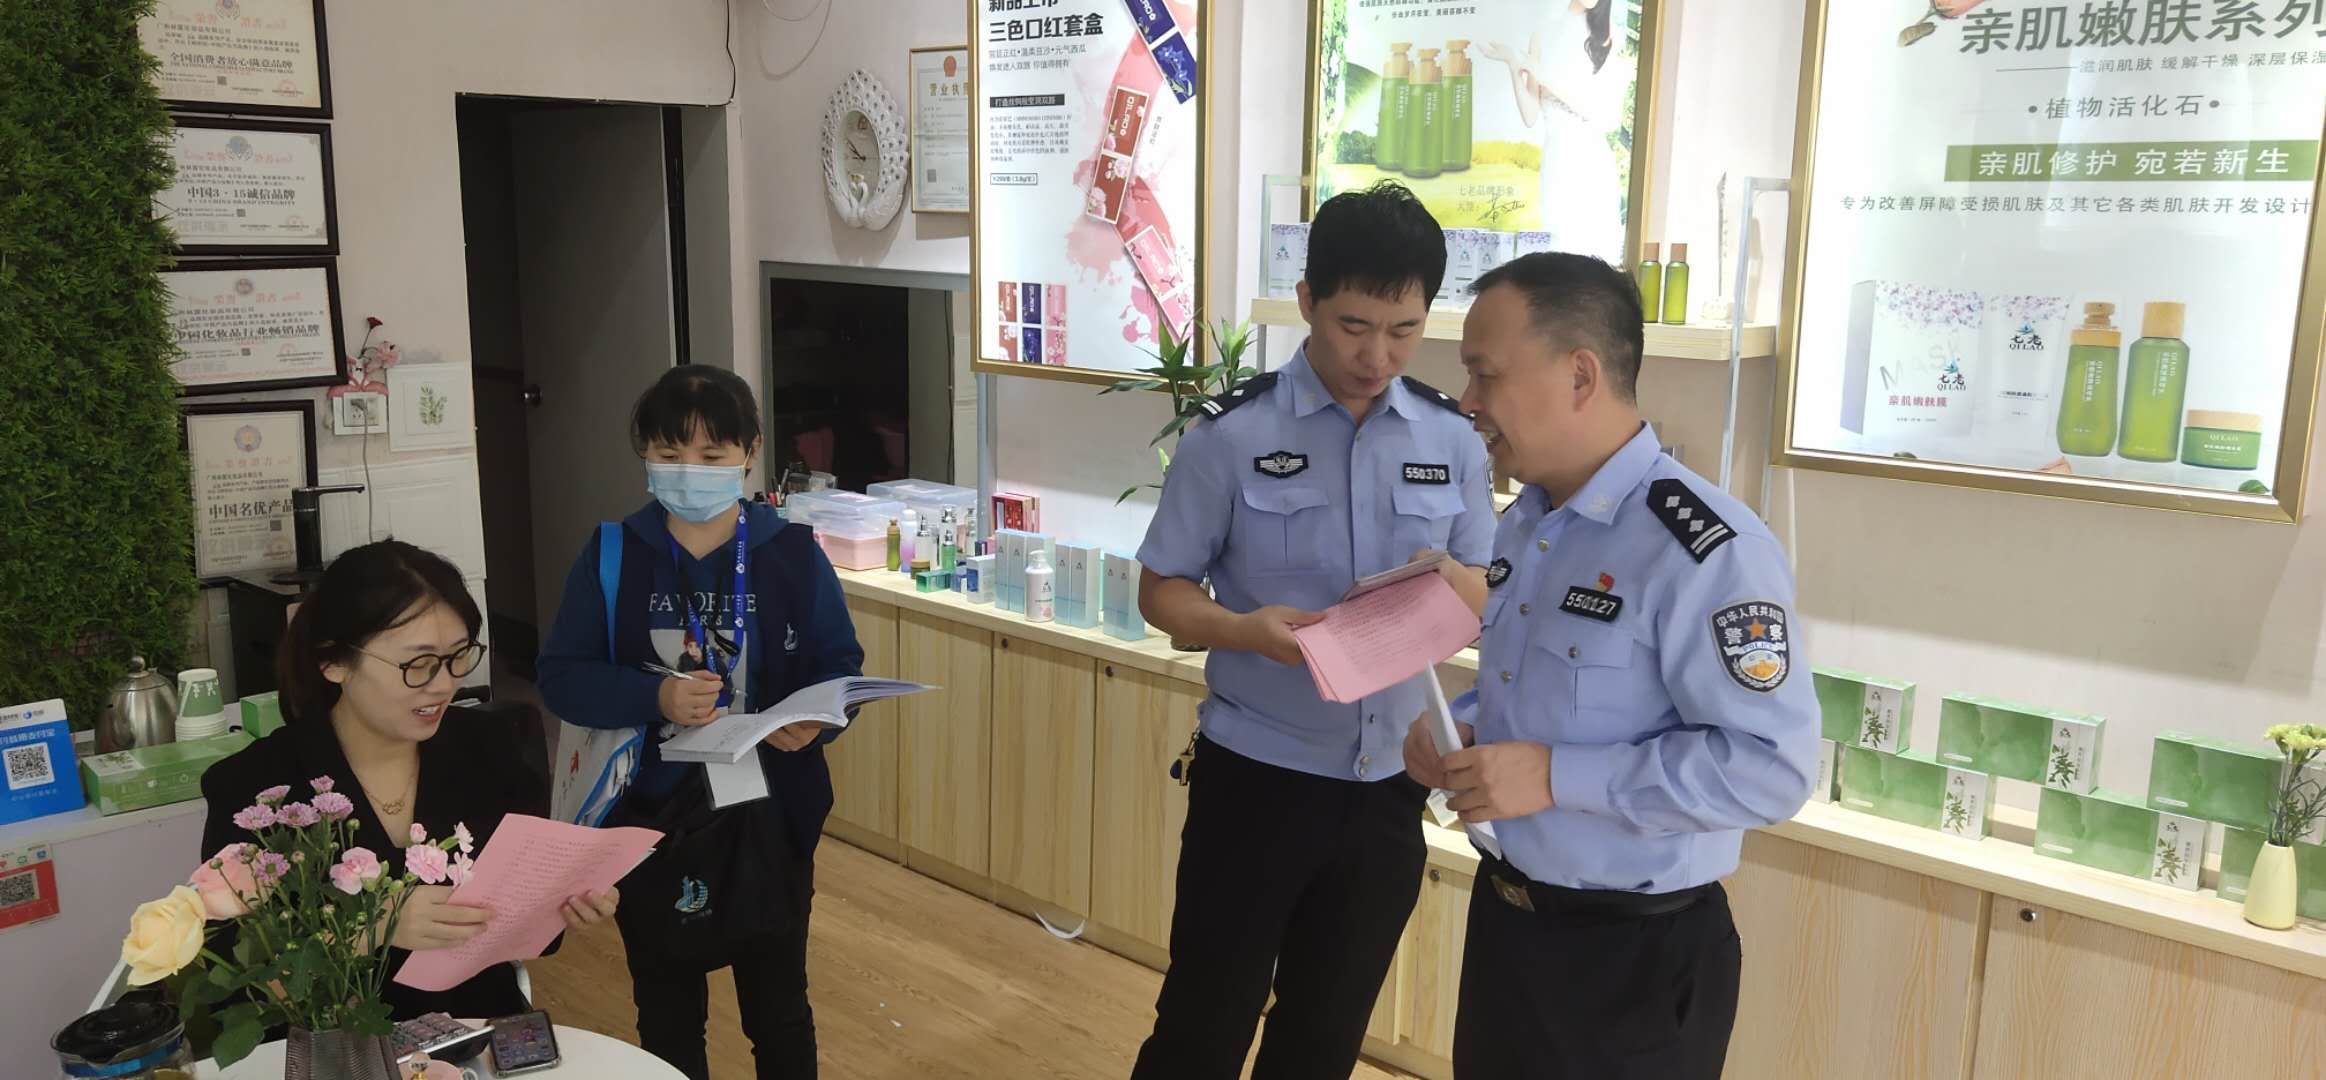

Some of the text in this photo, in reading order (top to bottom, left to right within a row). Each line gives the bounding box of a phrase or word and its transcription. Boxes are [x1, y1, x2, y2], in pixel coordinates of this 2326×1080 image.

[989, 12, 1104, 42] 三色口红套盒
[1959, 0, 2326, 54] 亲肌嫩肤系列
[2079, 59, 2153, 74] 滋润肌肤
[2161, 54, 2240, 71] 缓解干燥
[2044, 94, 2205, 120] 植物活化石
[1979, 147, 2290, 176] 亲肌修护 宛若新生
[1839, 195, 2313, 215] 专为改善屏障受损肌肤及其它各类肌肤开发设计
[1404, 466, 1447, 482] 550370
[1716, 604, 1784, 628] 中华人民共和国
[1769, 623, 1783, 641] 察
